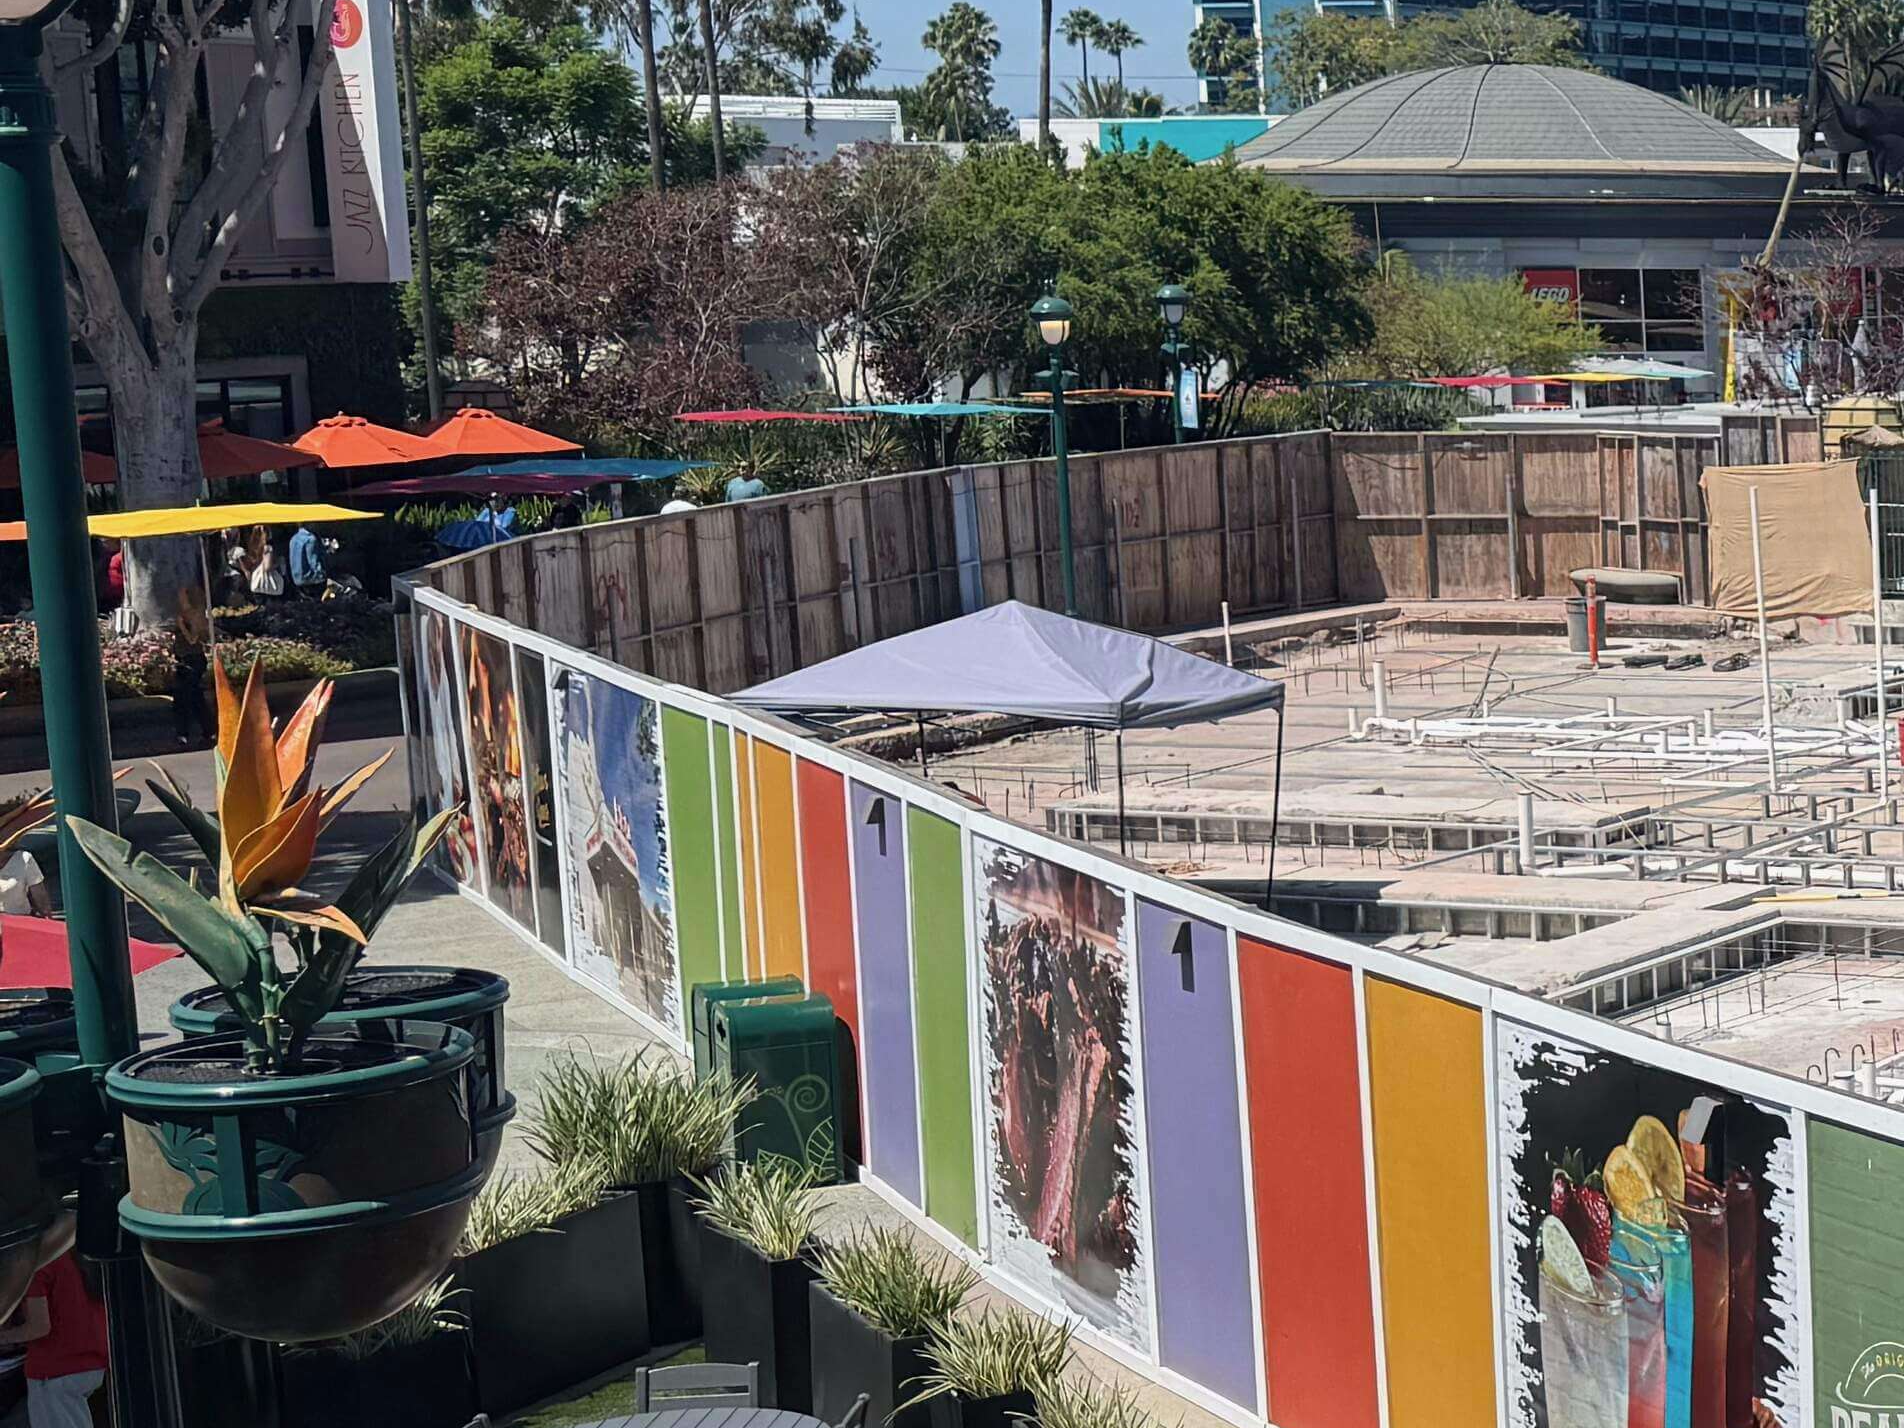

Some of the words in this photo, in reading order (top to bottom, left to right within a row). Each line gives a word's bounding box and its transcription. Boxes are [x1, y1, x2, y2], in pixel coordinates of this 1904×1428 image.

[335, 73, 365, 175] KITCHEN
[343, 189, 373, 254] JAZZ
[1530, 287, 1570, 303] LEGO
